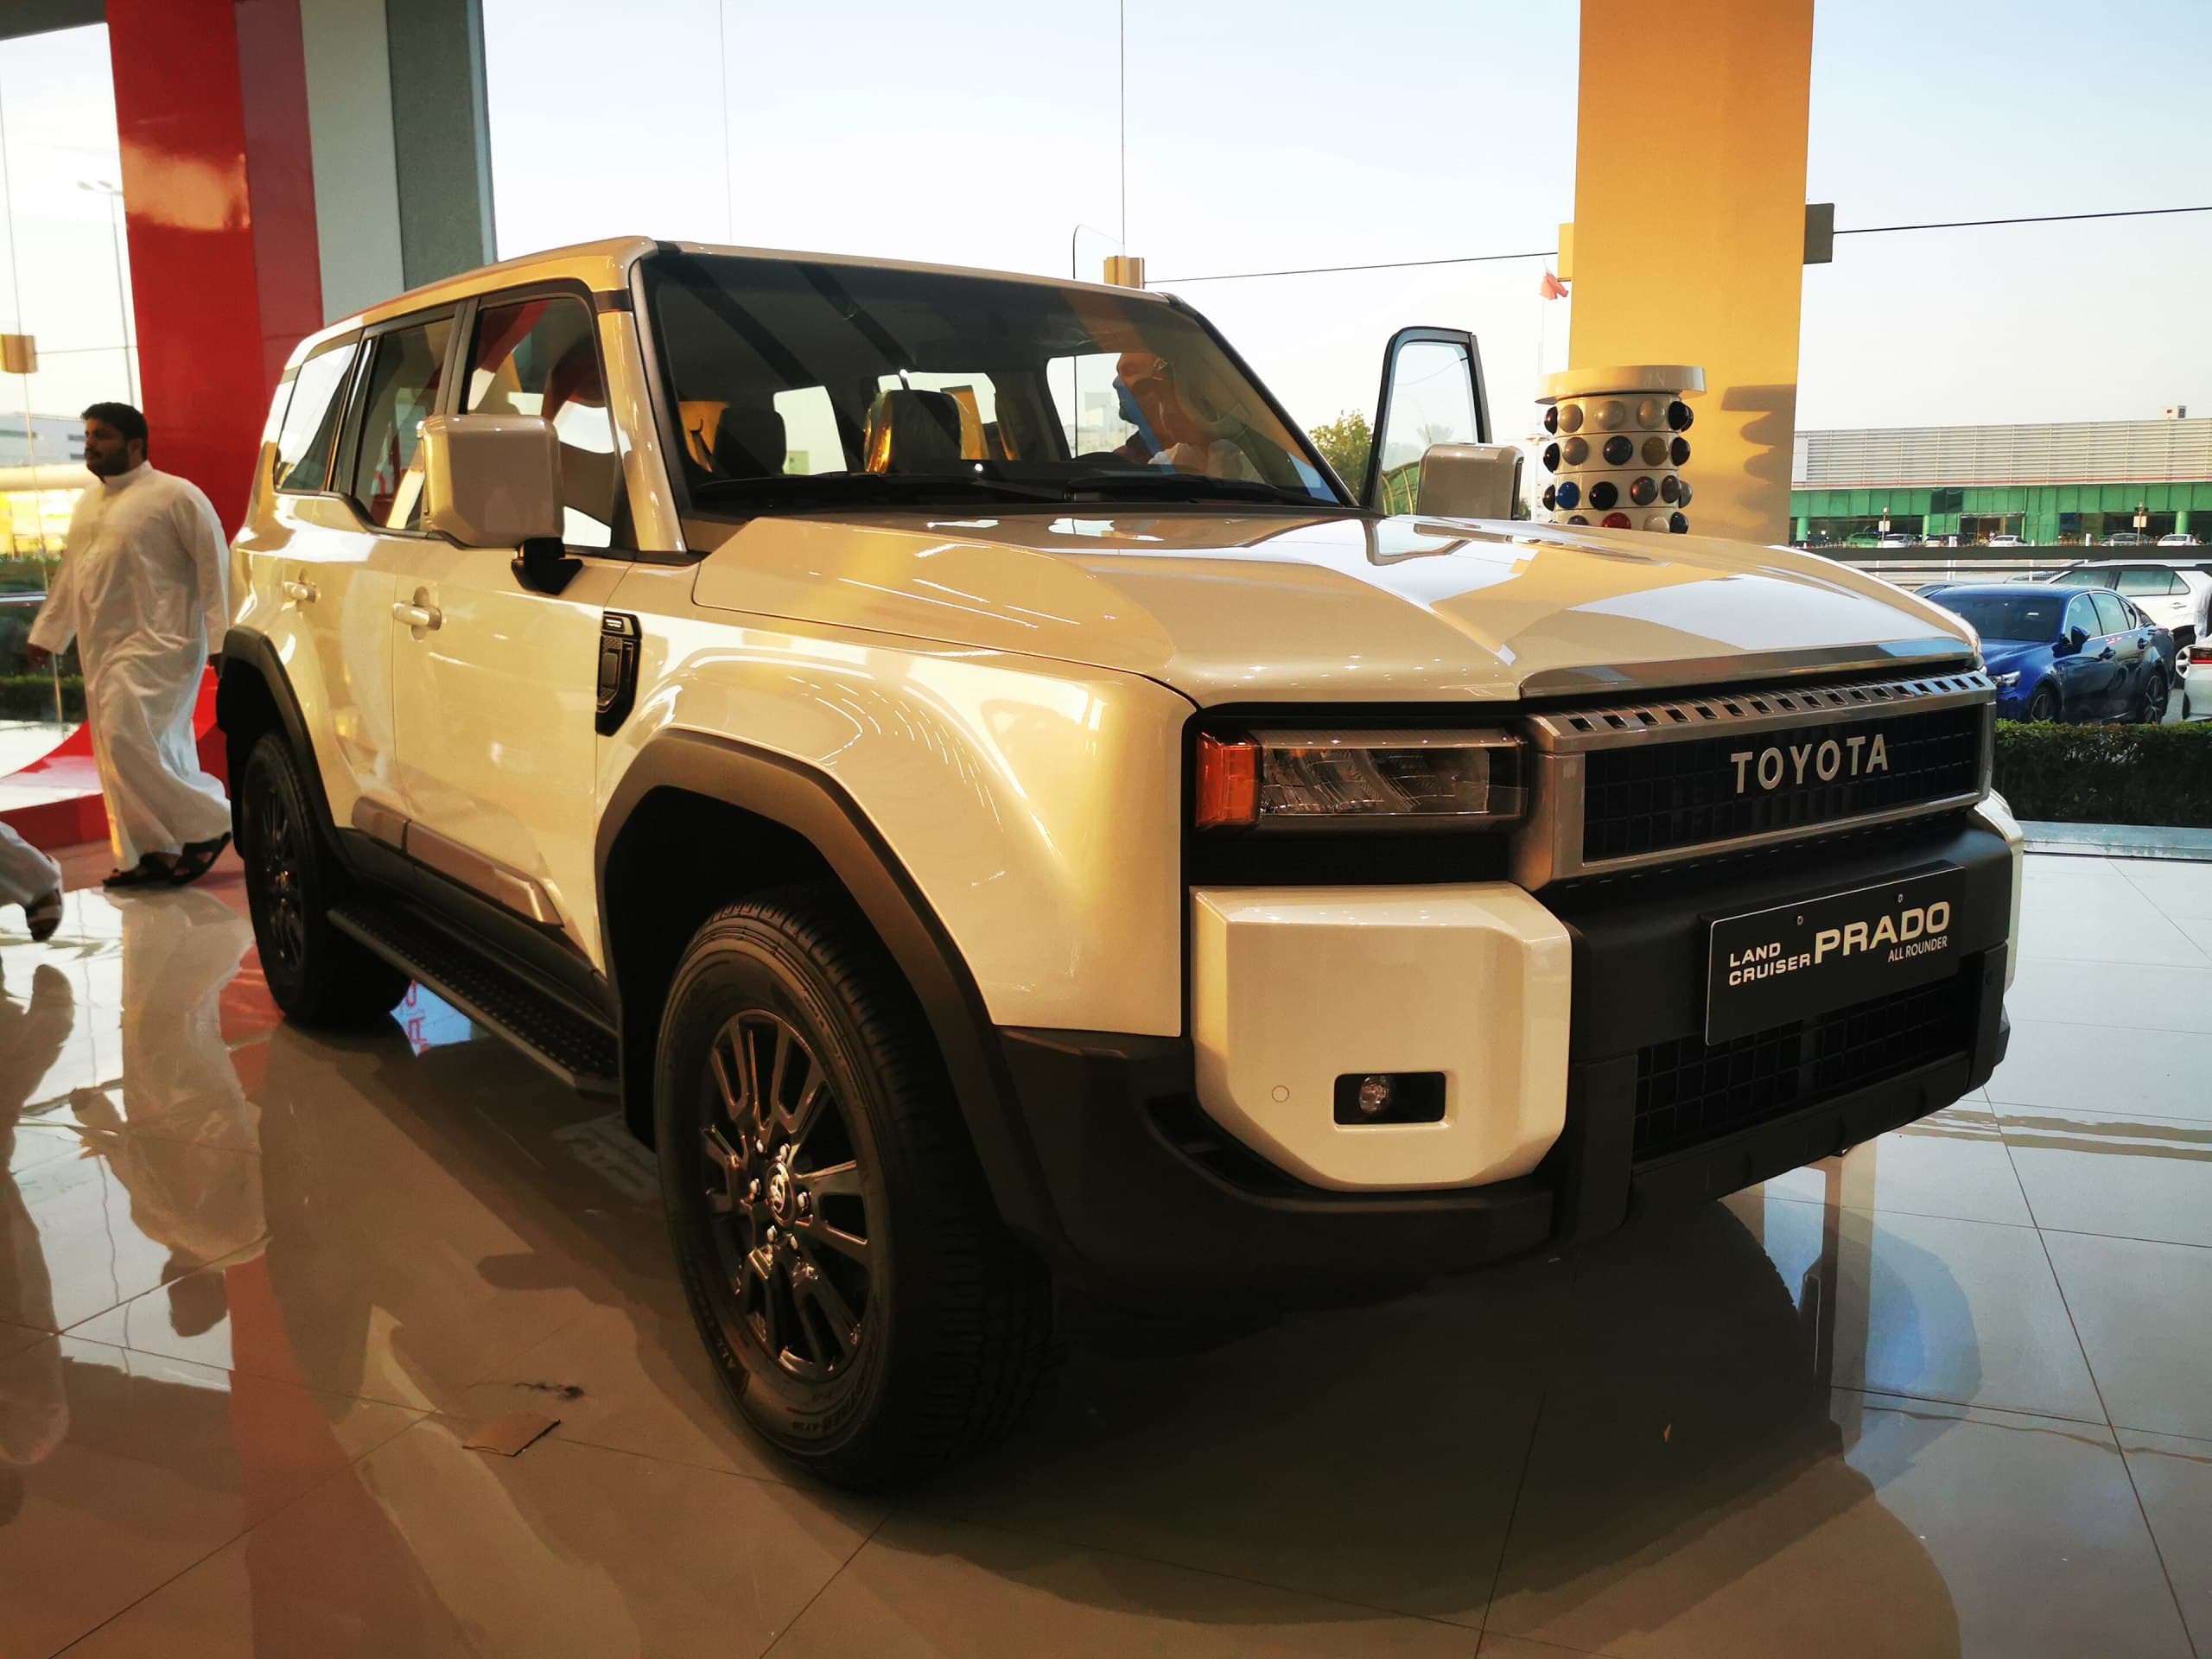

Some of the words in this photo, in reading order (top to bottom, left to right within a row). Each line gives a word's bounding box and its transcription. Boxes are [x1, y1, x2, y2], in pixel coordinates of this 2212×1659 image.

[1731, 734, 1888, 793] TOYOTA
[1815, 901, 1950, 964] PRADO
[1887, 947, 1904, 963] ALL
[1904, 936, 1948, 958] ROUNDER
[1728, 953, 1811, 987] CRUISER
[1729, 942, 1781, 968] LAND
